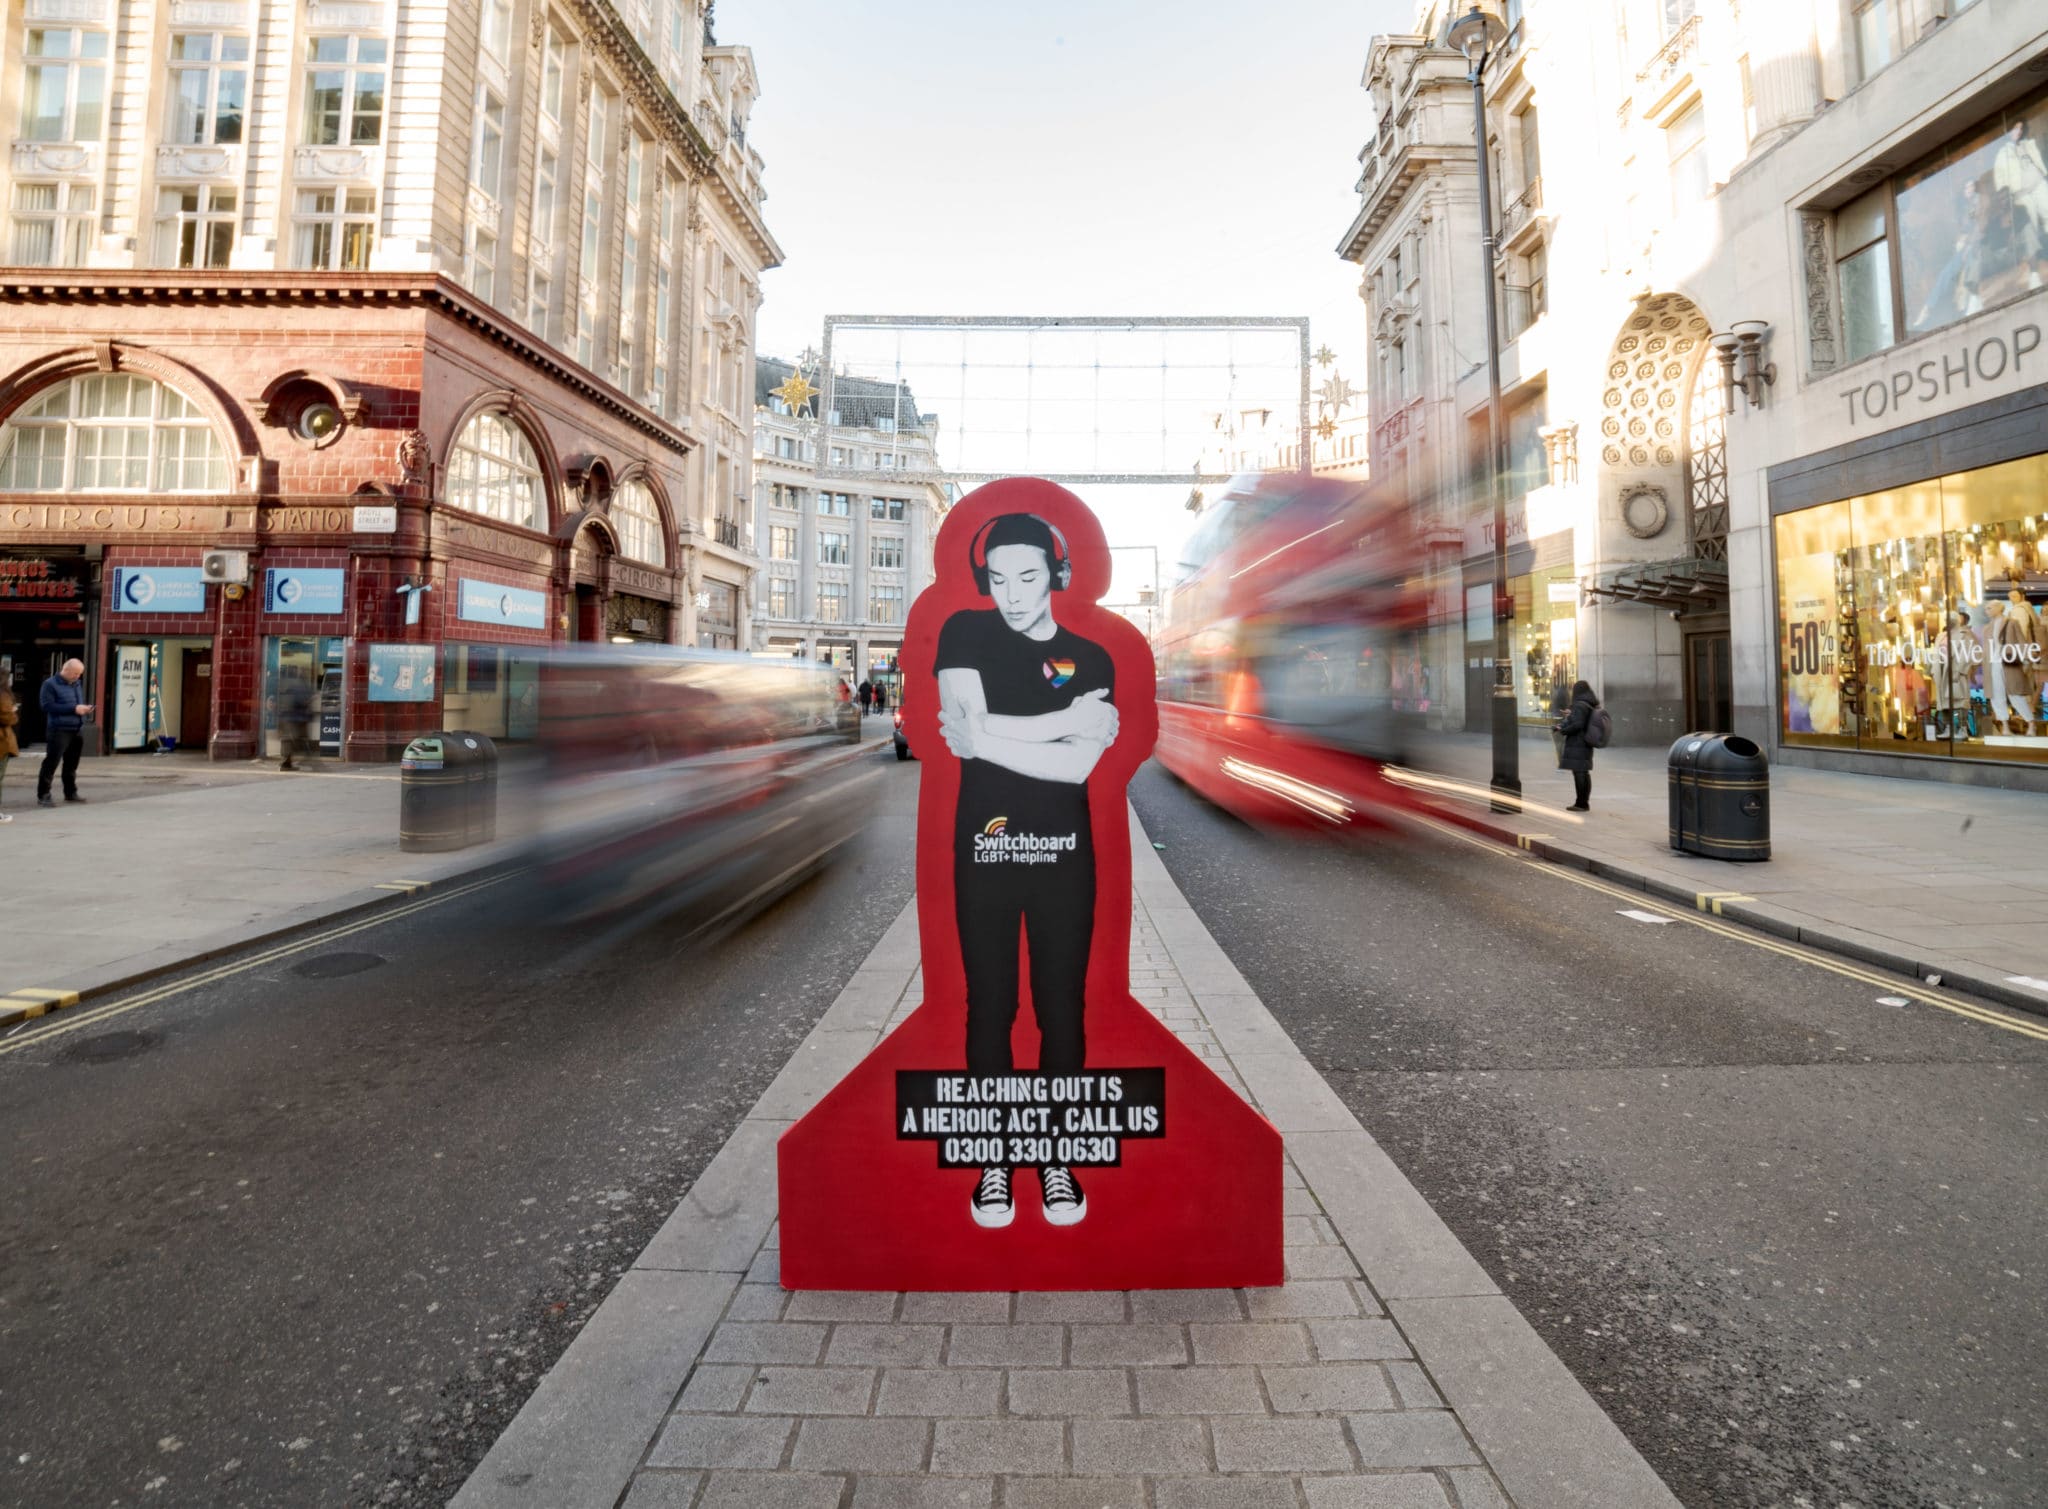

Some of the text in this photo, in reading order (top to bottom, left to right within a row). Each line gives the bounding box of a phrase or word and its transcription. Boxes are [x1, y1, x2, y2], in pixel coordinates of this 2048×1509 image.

[1839, 323, 2042, 426] TOPSHOP
[10, 505, 182, 531] CIRCUS
[466, 525, 546, 562] OXFORD
[16, 580, 76, 597] HOUSES
[619, 566, 663, 589] CIRCUS
[1821, 654, 1834, 675] OFF
[1901, 641, 1948, 665] Ones
[1951, 639, 1984, 664] We
[1988, 638, 2042, 664] Love
[123, 660, 142, 671] ATM
[974, 832, 1076, 851] Switchboard
[974, 850, 1057, 865] LGBT+ helpline
[936, 1075, 1123, 1102] REACHING OUT IS
[902, 1105, 1159, 1137] A HEROIC ACT, CALL US
[944, 1136, 1117, 1163] 0300 330 0630
